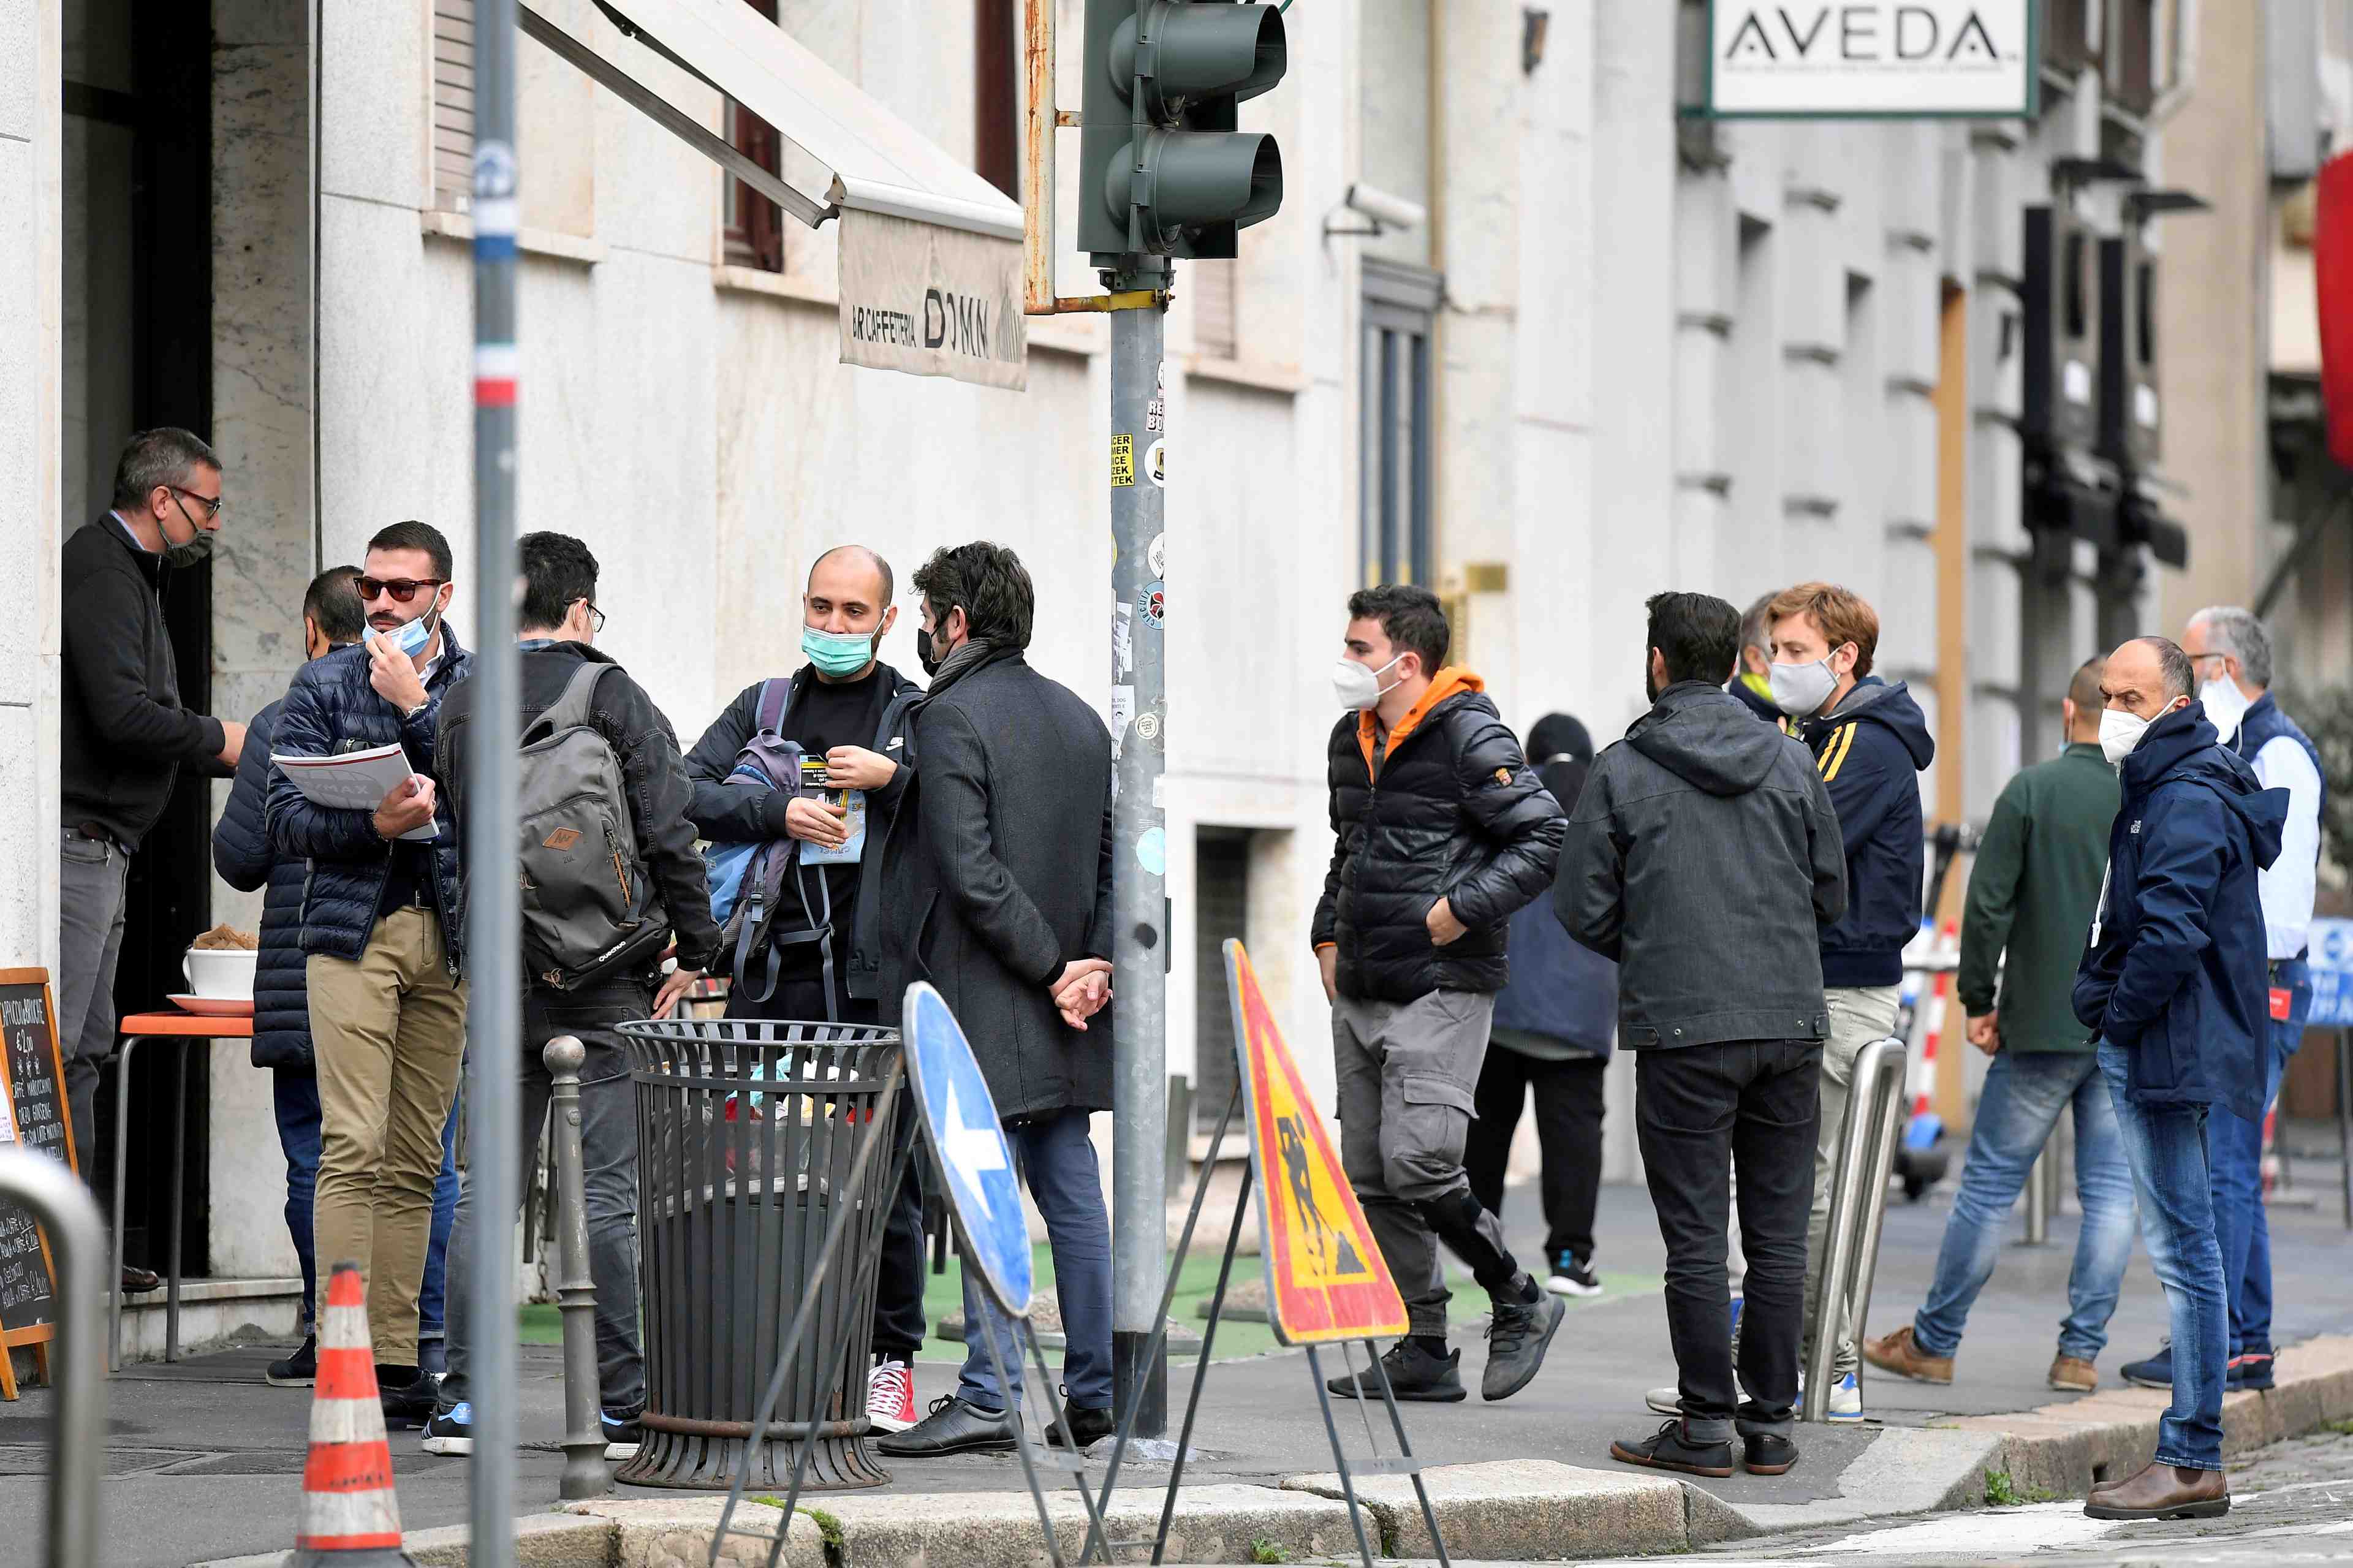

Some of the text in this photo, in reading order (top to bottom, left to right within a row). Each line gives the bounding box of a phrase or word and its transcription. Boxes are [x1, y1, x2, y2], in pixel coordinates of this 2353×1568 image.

[1724, 7, 1998, 59] AVEDA
[1149, 400, 1164, 417] RE
[1148, 415, 1164, 431] BO
[598, 940, 626, 962] Quechua
